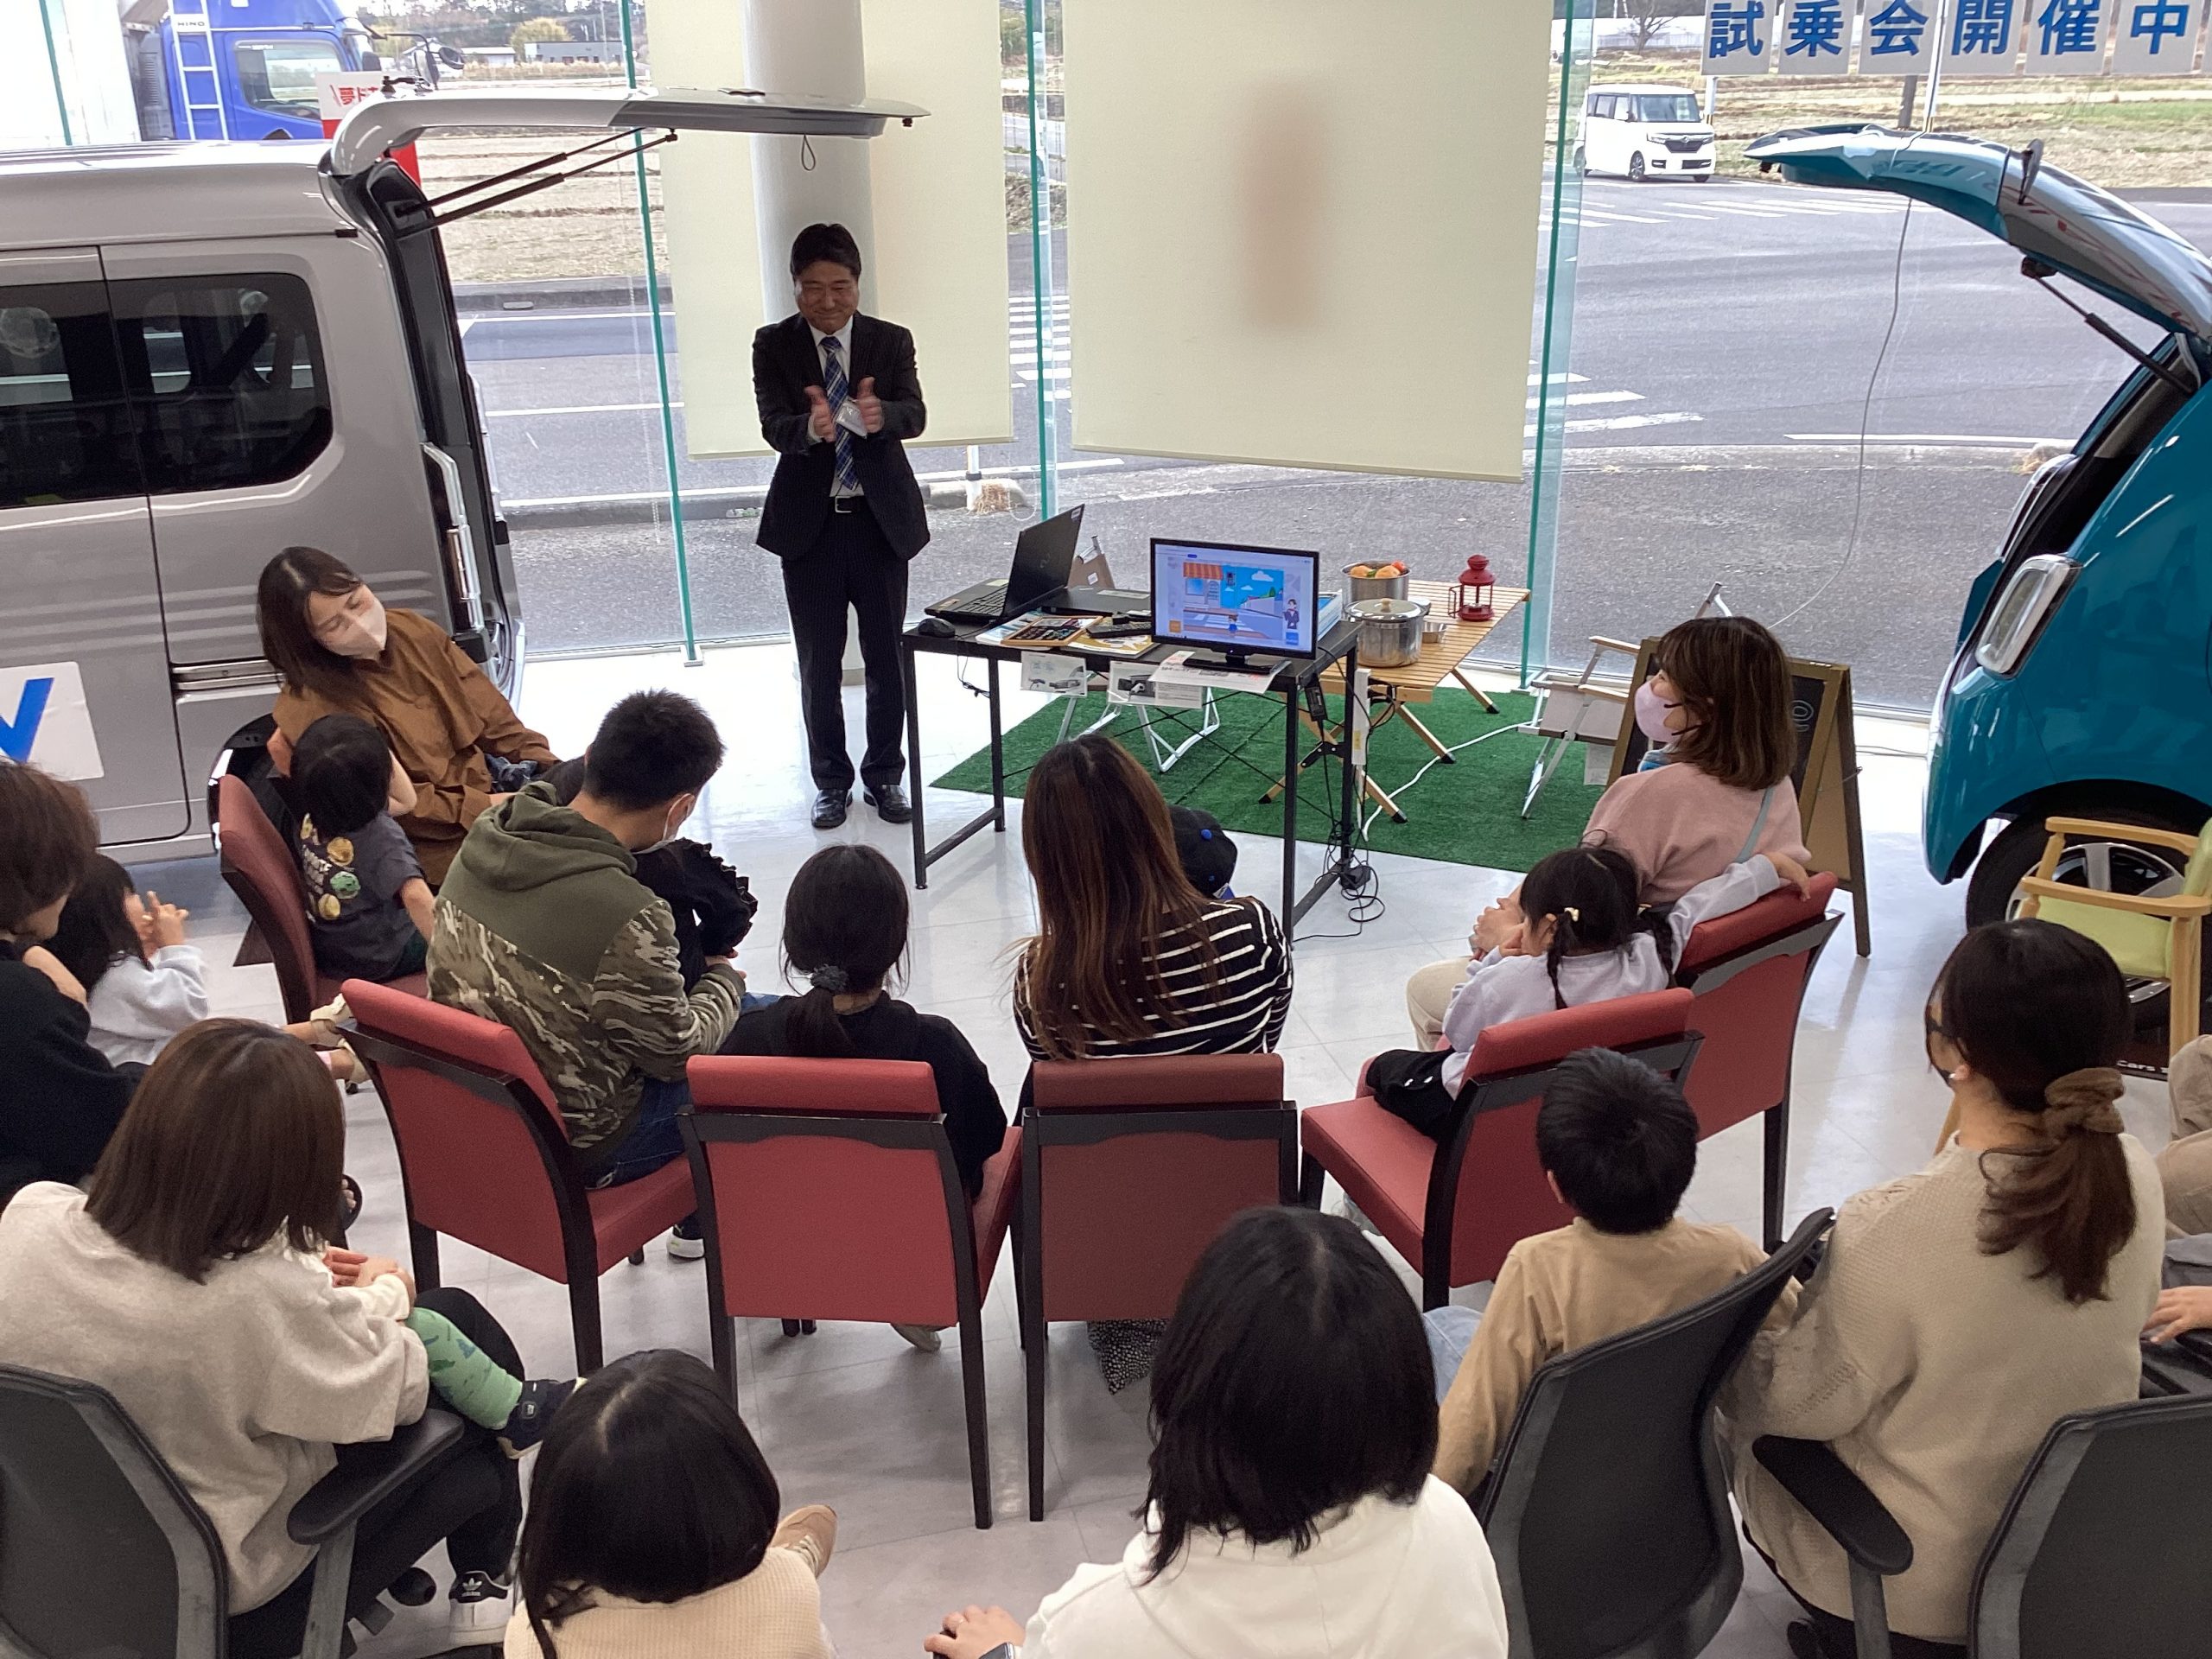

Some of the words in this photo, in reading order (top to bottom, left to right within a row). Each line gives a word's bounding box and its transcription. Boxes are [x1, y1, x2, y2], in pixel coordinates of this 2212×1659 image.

[1708, 0, 2190, 59] 試乗会開催中
[2116, 1059, 2157, 1072] Cars
